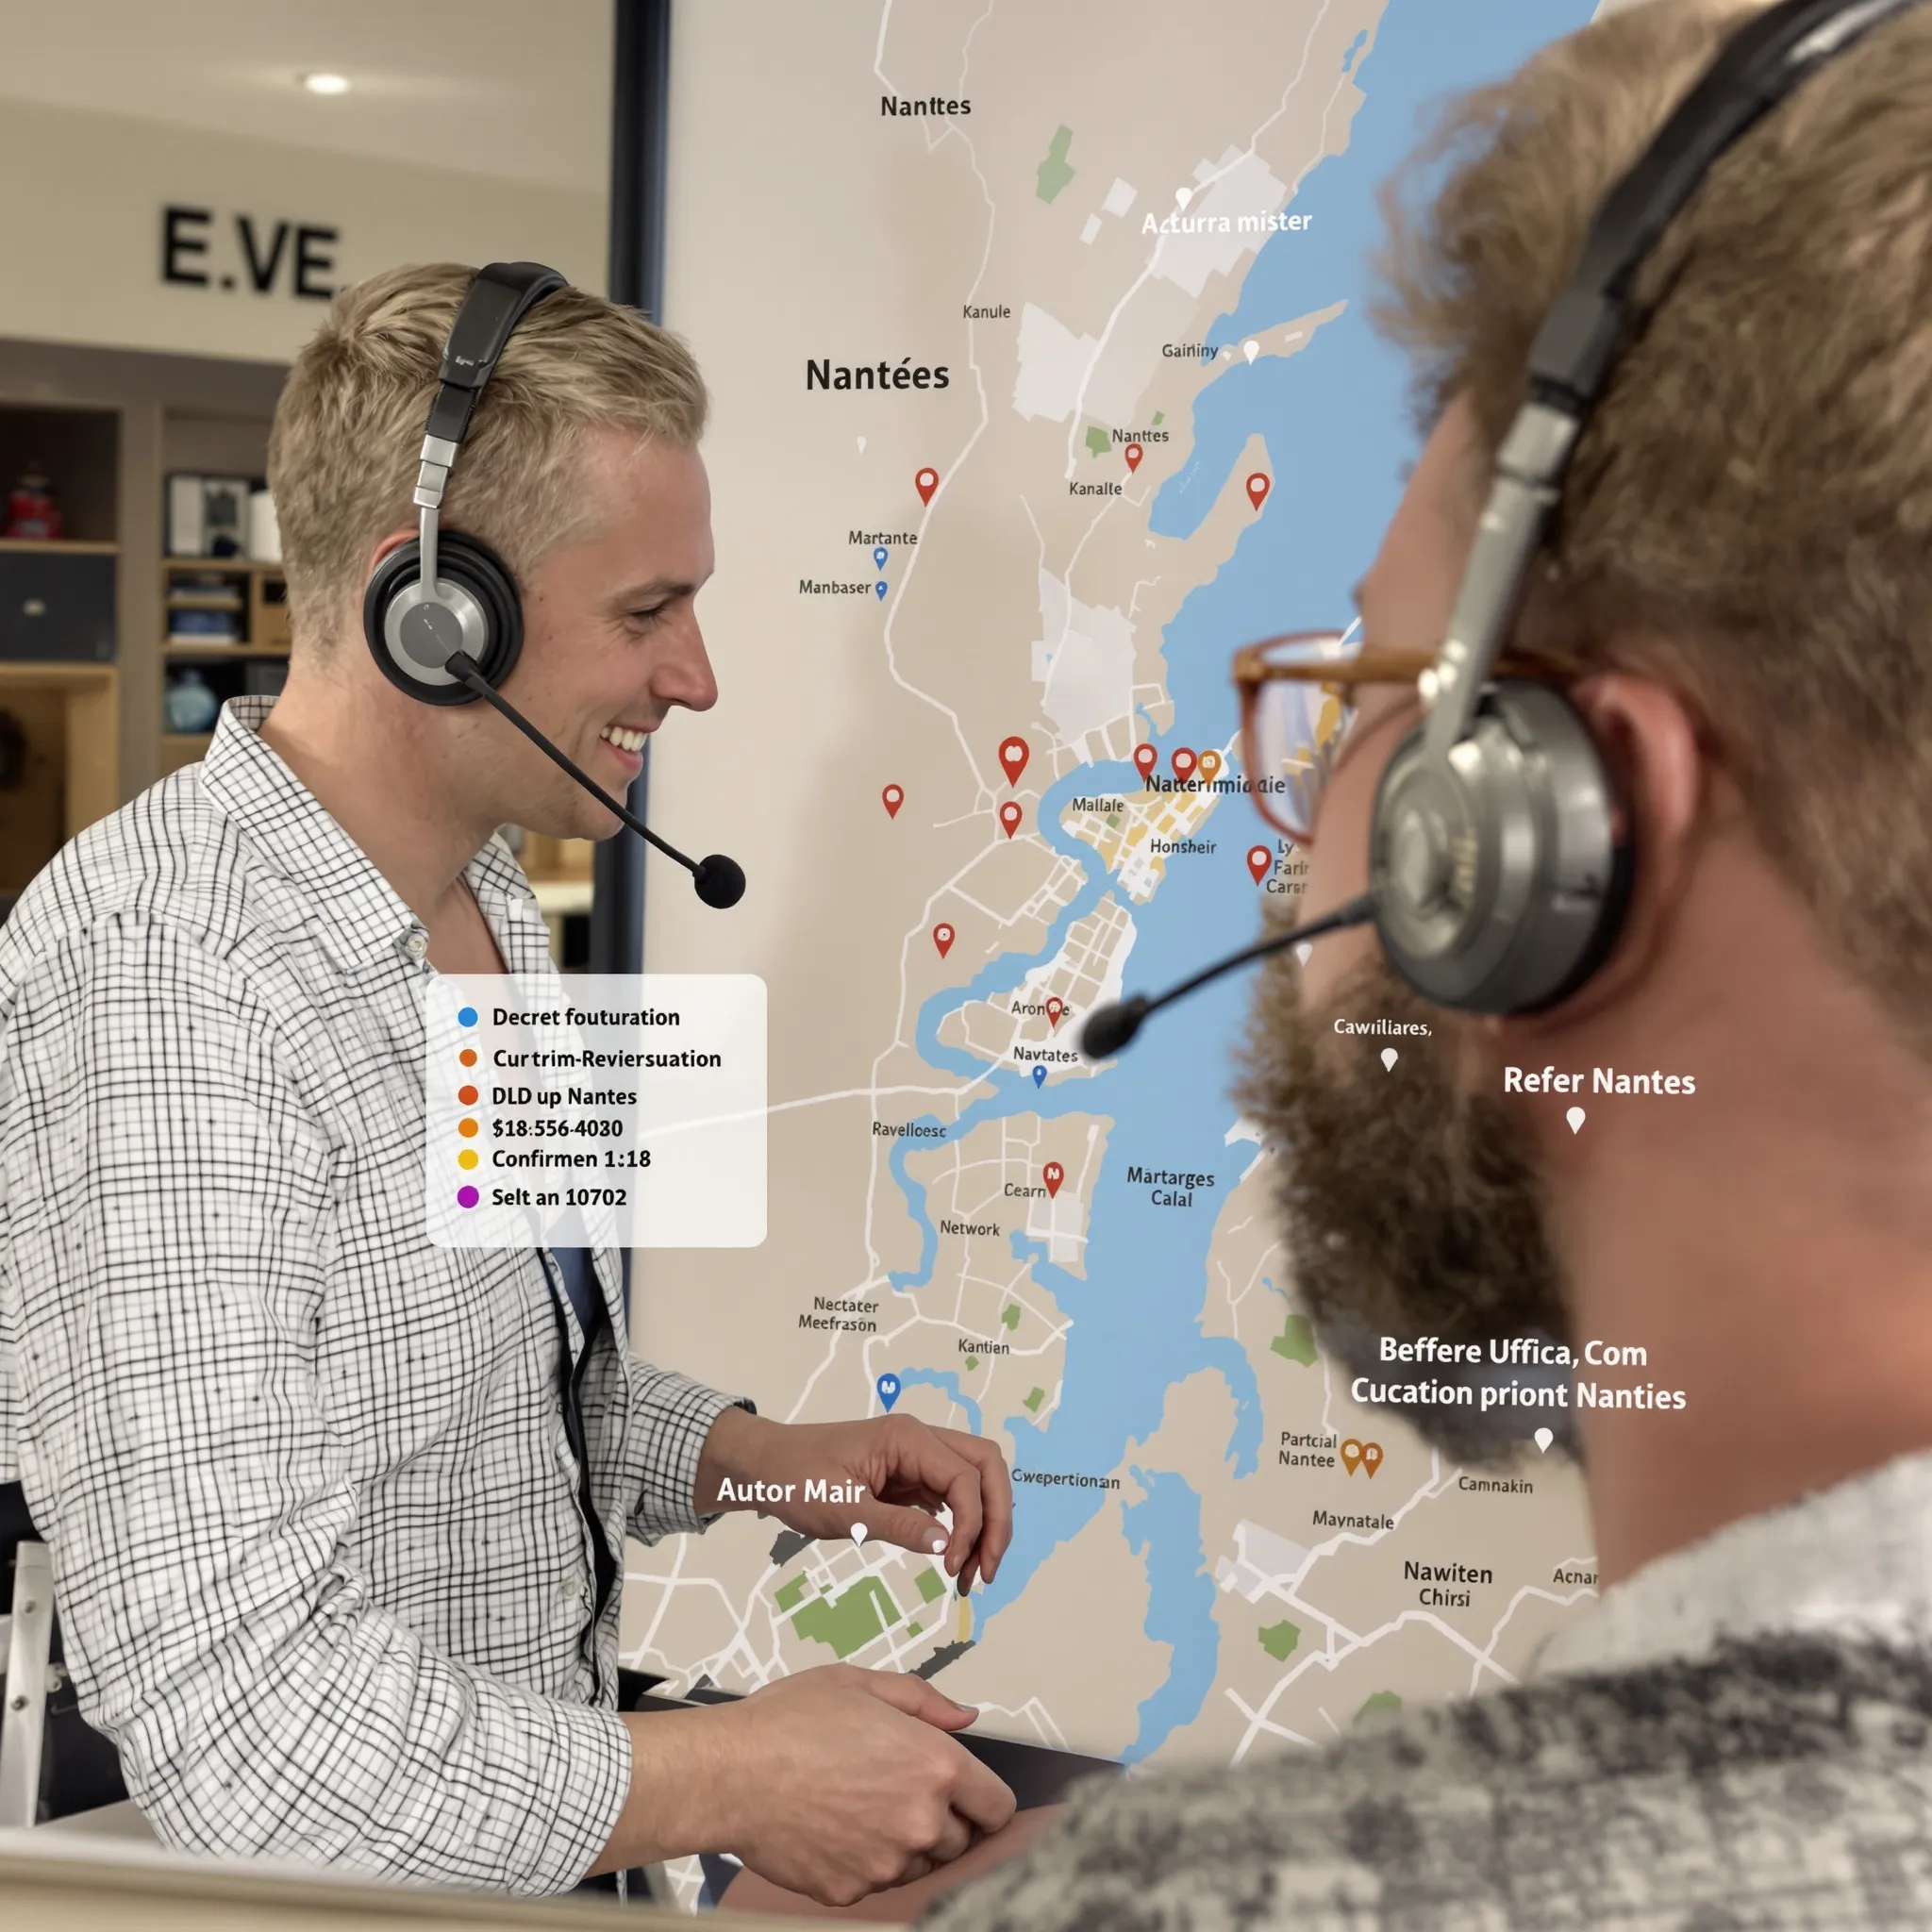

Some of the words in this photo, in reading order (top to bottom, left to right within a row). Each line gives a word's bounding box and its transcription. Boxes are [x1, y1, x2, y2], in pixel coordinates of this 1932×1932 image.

[881, 95, 972, 116] Nanttes
[1238, 209, 1313, 233] mister
[963, 305, 1011, 319] Kanule
[807, 357, 950, 390] Nantées
[849, 530, 918, 545] Martante
[799, 579, 872, 594] Manbaser
[1151, 839, 1217, 854] Honsheir
[1011, 1001, 1070, 1016] Arone
[1151, 1190, 1193, 1208] Calal
[941, 1220, 1000, 1237] Network
[813, 1297, 879, 1313] Nectater
[1279, 1451, 1336, 1468] Nantee
[1458, 1476, 1534, 1494] Camnakin
[1312, 1511, 1395, 1531] Maynatale
[1404, 1561, 1493, 1584] Nawiten
[1419, 1589, 1471, 1607] Chirsi
